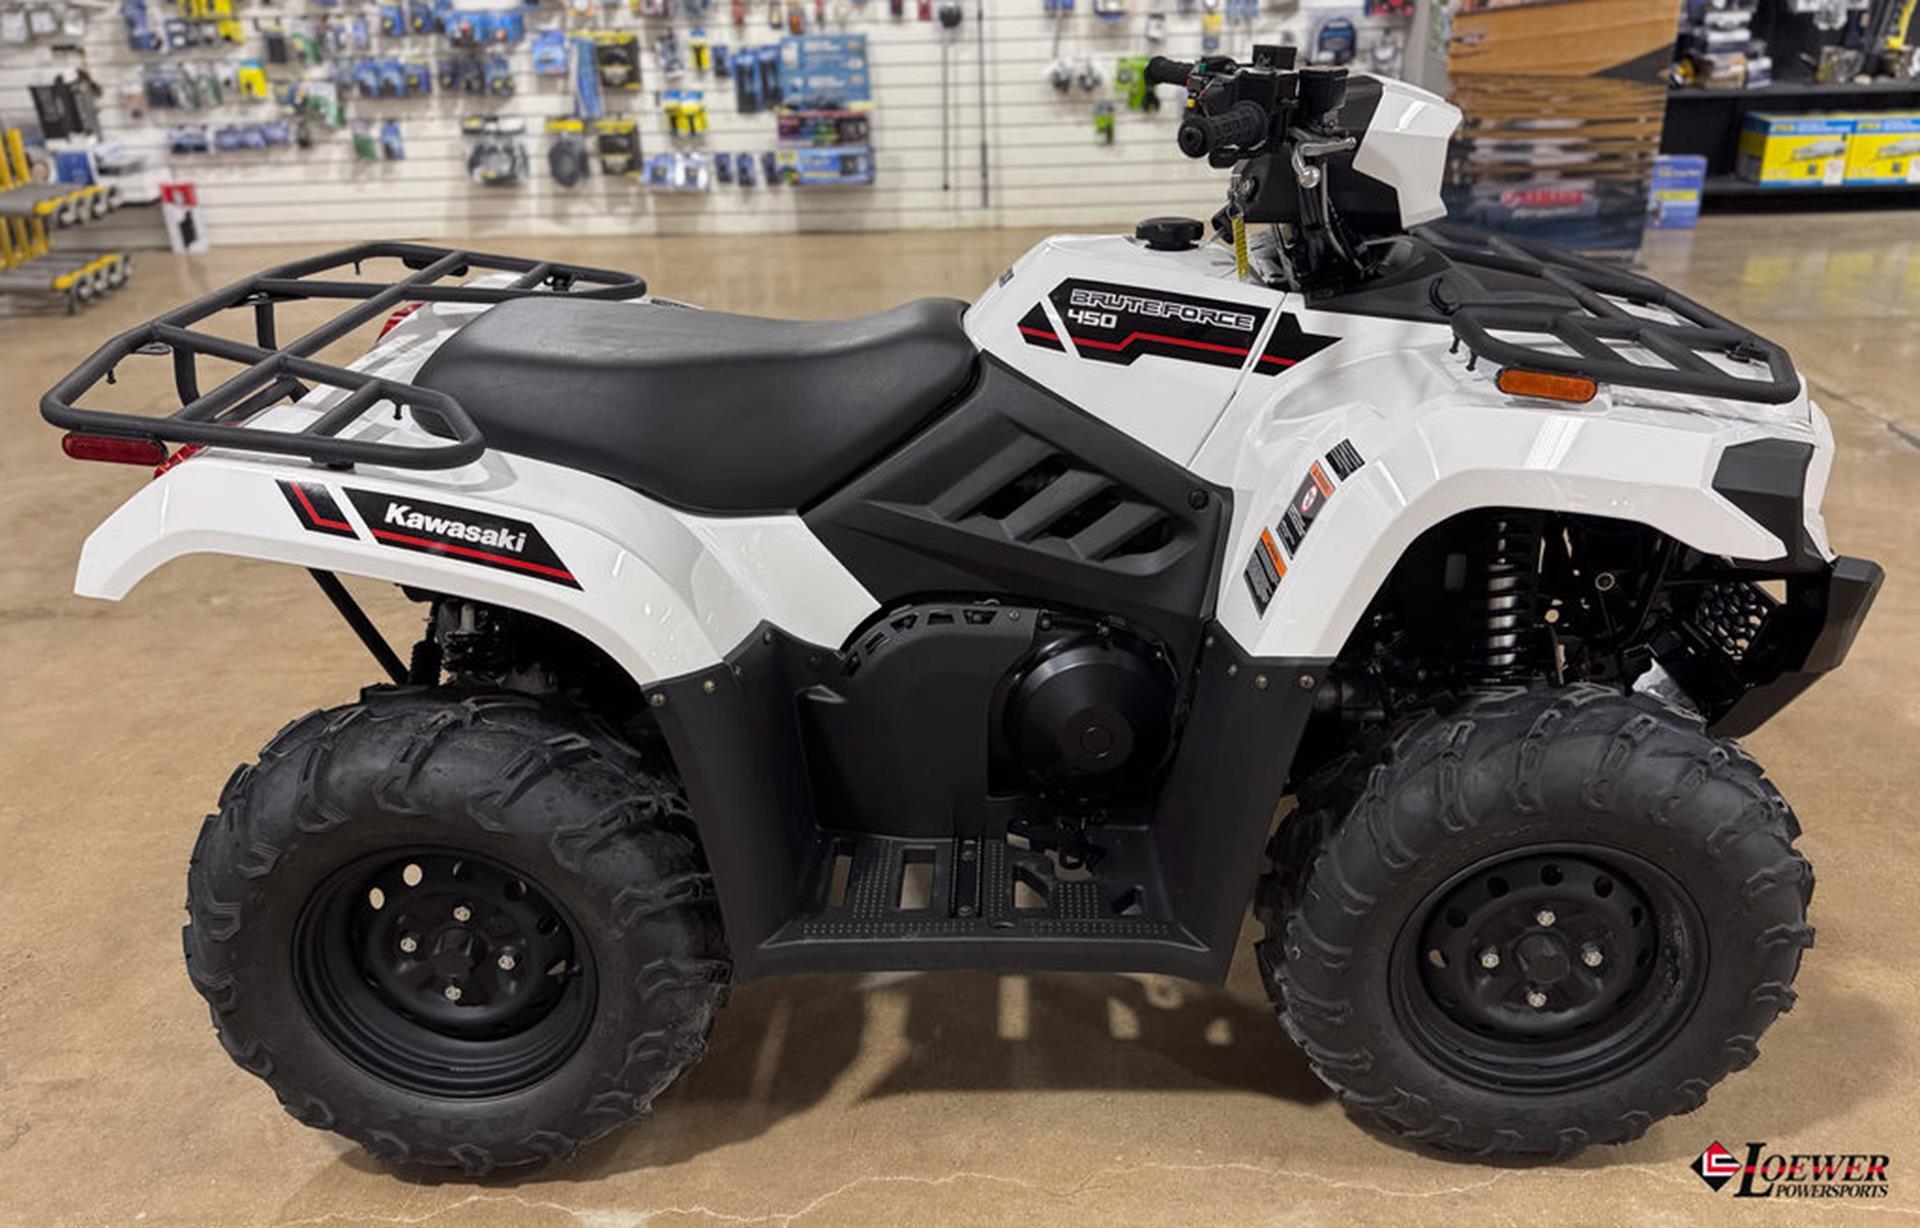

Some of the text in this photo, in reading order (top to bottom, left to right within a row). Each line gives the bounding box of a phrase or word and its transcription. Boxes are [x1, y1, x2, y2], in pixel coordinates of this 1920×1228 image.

[1068, 308, 1118, 329] 450
[1070, 288, 1256, 331] BRUTE FORCE
[384, 502, 527, 552] Kawasaki
